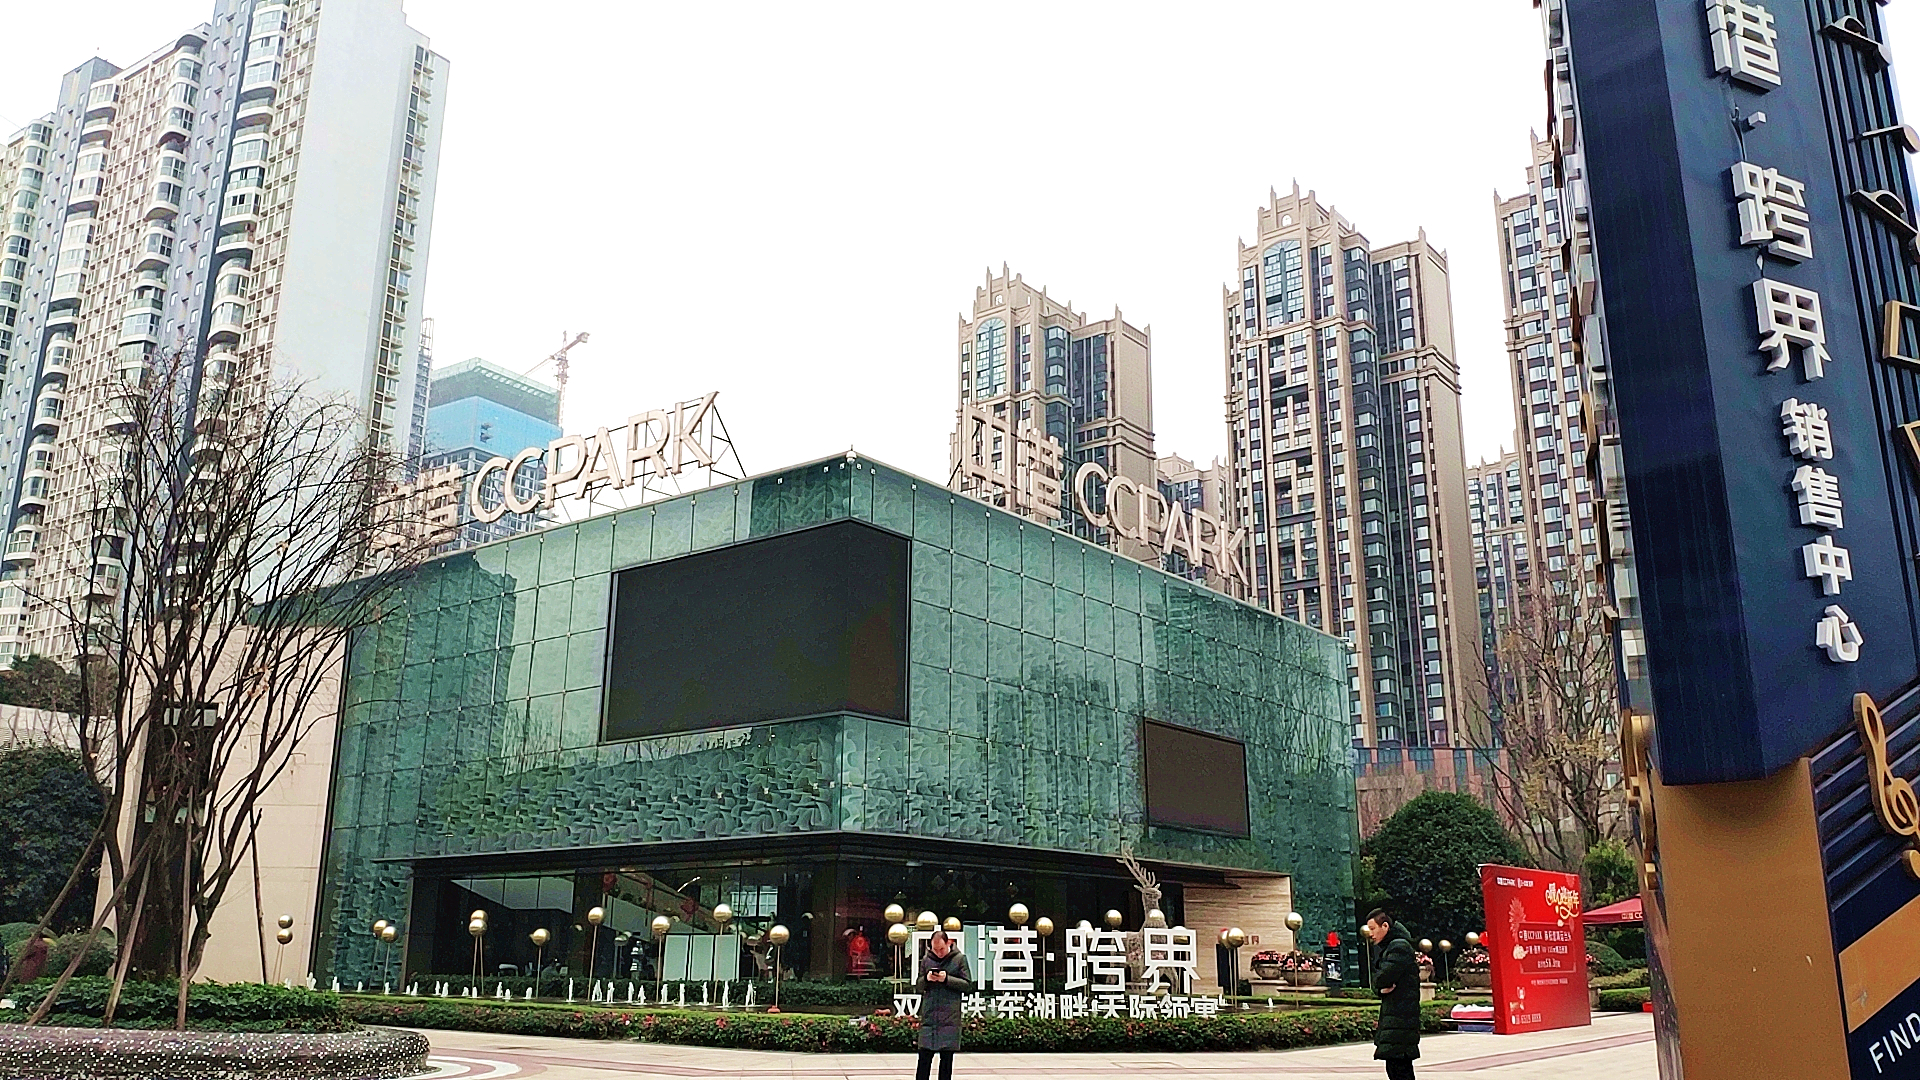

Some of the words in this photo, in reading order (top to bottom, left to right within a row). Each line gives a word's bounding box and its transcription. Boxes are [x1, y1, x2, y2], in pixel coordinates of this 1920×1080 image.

[470, 391, 719, 523] CCPARK
[1074, 461, 1249, 586] CCPARK
[1781, 397, 1864, 663] 销售中心
[893, 991, 1218, 1019] 双铁东湖畔天际领寓
